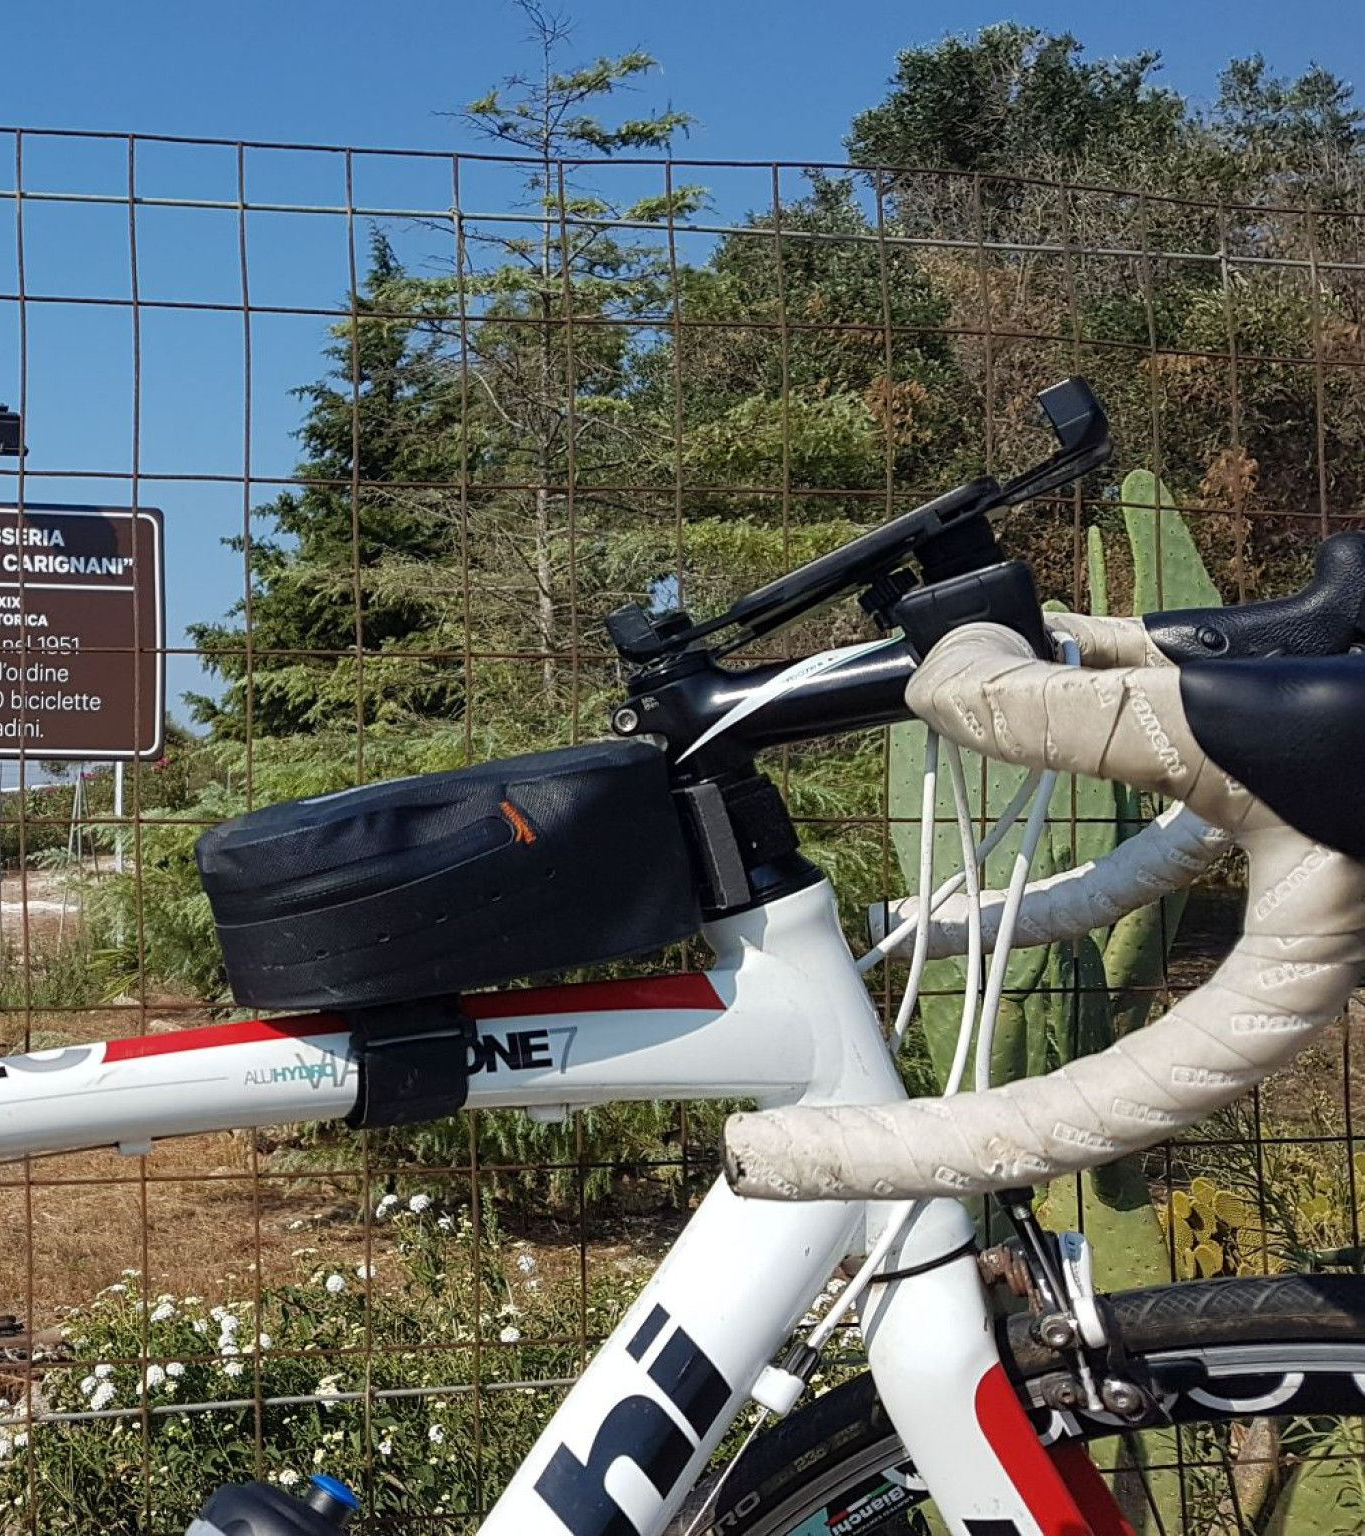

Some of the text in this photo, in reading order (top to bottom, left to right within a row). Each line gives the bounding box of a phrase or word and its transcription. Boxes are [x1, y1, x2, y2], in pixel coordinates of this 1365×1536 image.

[36, 635, 80, 656] 1951
[10, 689, 102, 711] biciclette
[831, 1484, 907, 1536] Bianchi
